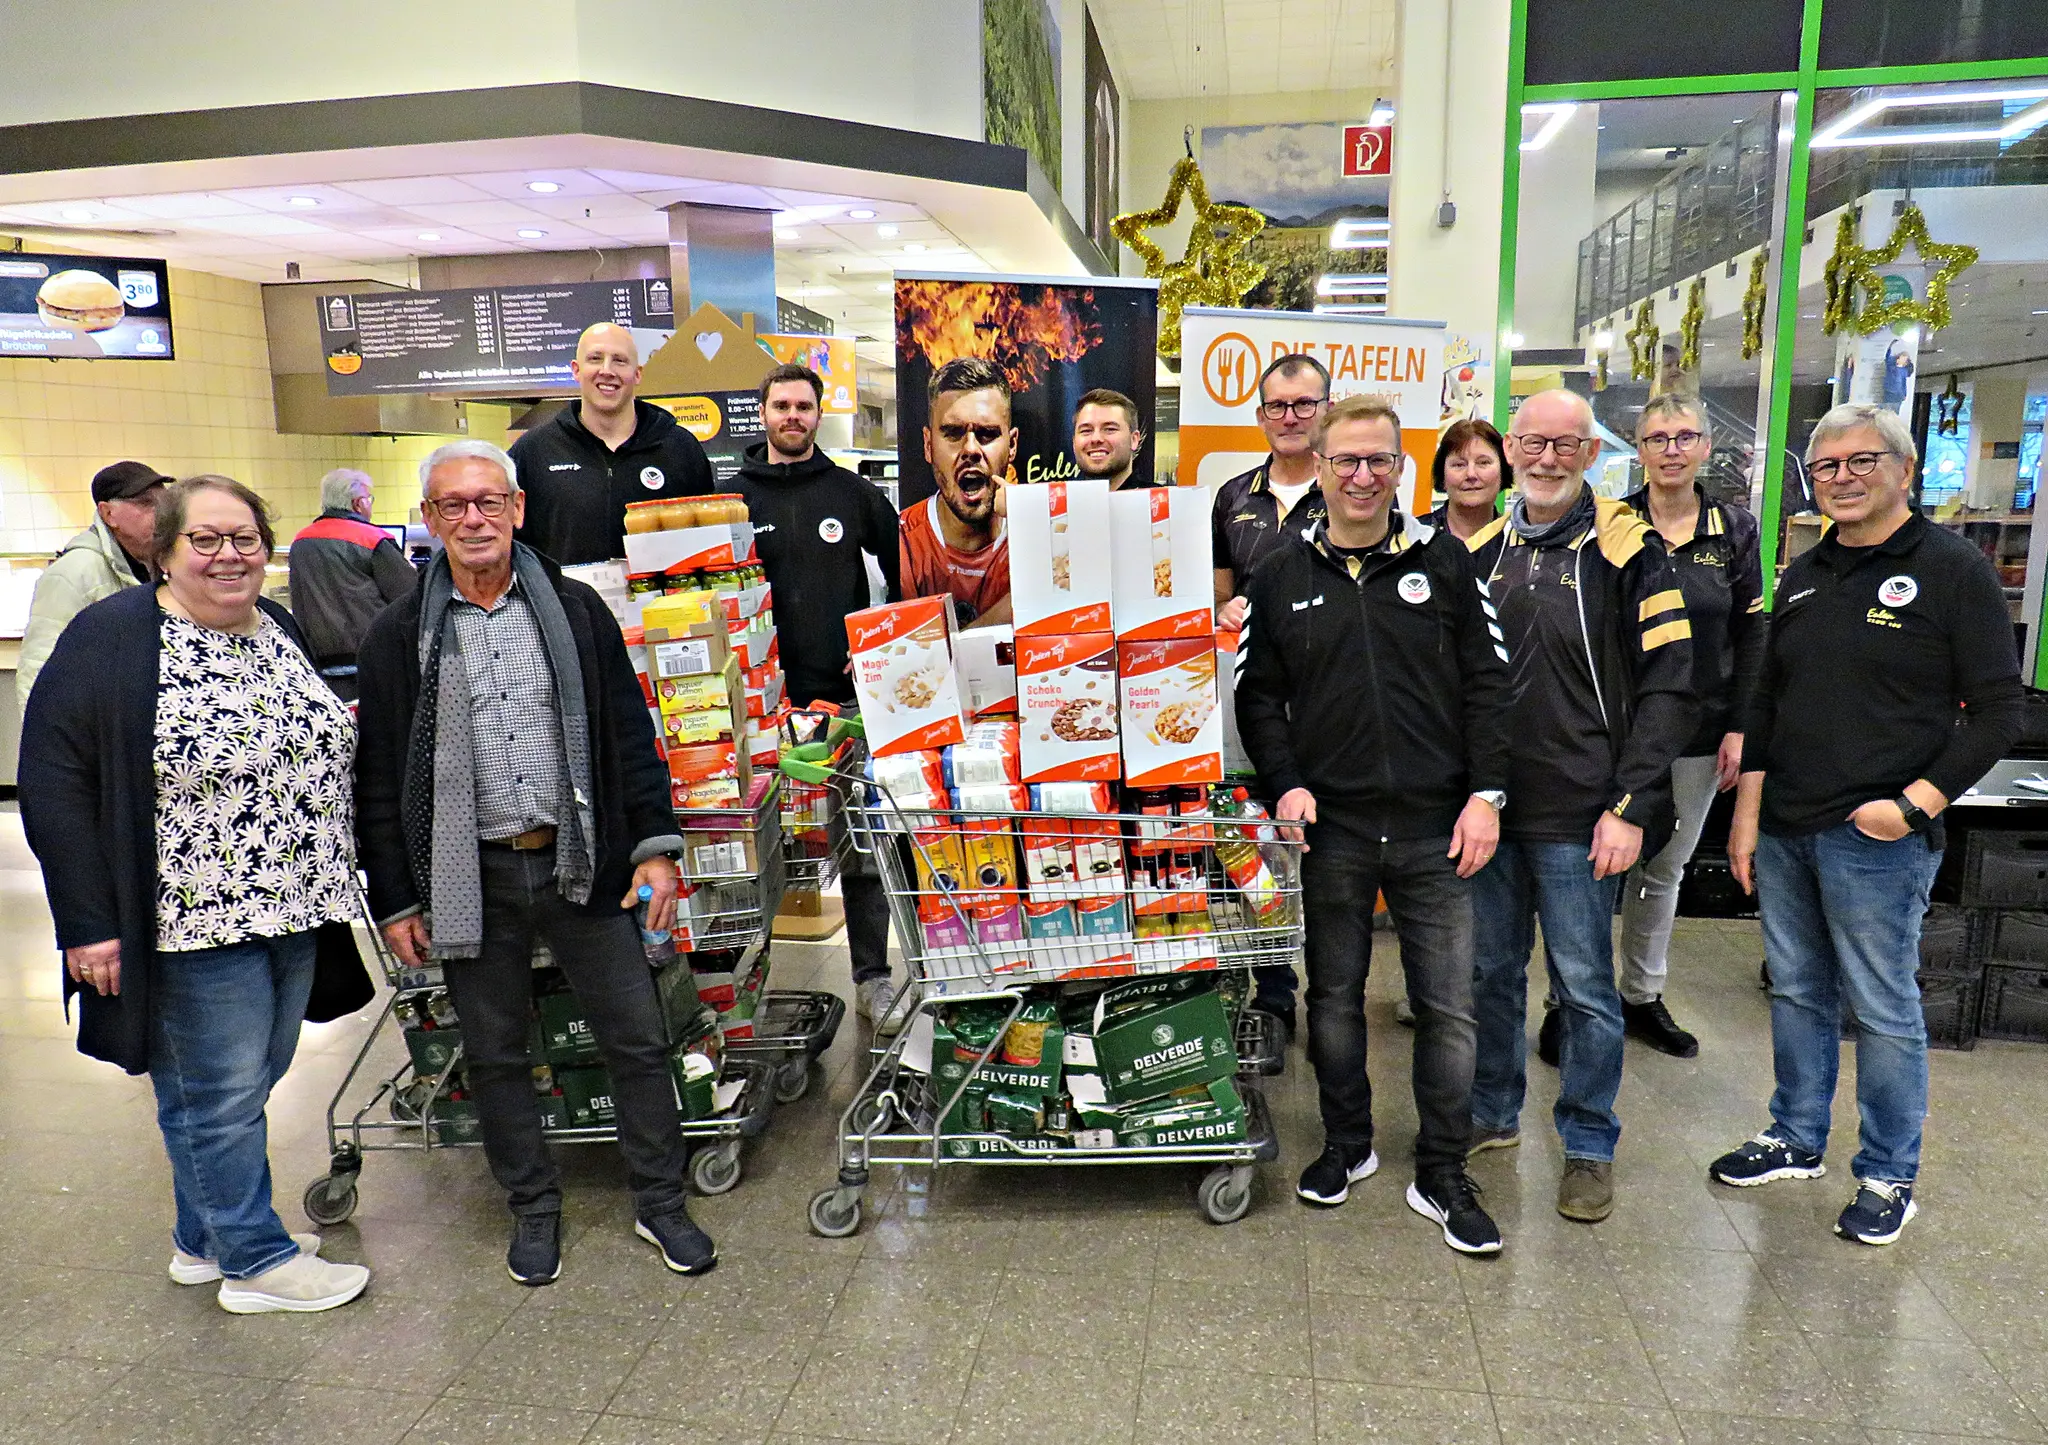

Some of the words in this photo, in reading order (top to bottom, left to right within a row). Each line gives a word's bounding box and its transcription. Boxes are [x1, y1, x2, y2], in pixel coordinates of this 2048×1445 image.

[1325, 343, 1426, 383] TAFELN
[675, 412, 709, 422] emacht
[549, 463, 575, 472] CRAFT
[861, 658, 890, 670] Magic
[1024, 649, 1051, 670] Jeden
[863, 673, 883, 684] Zim
[1026, 684, 1062, 696] Schoko
[1128, 686, 1160, 697] Golden
[1027, 697, 1067, 710] Crunchy
[1129, 698, 1160, 709] Pearls
[689, 786, 730, 798] Hagebutte
[568, 1020, 591, 1035] DE
[1133, 1037, 1204, 1071] DELVERDE
[1156, 1122, 1237, 1144] DELVERDE
[979, 1140, 1059, 1153] DELERDE
